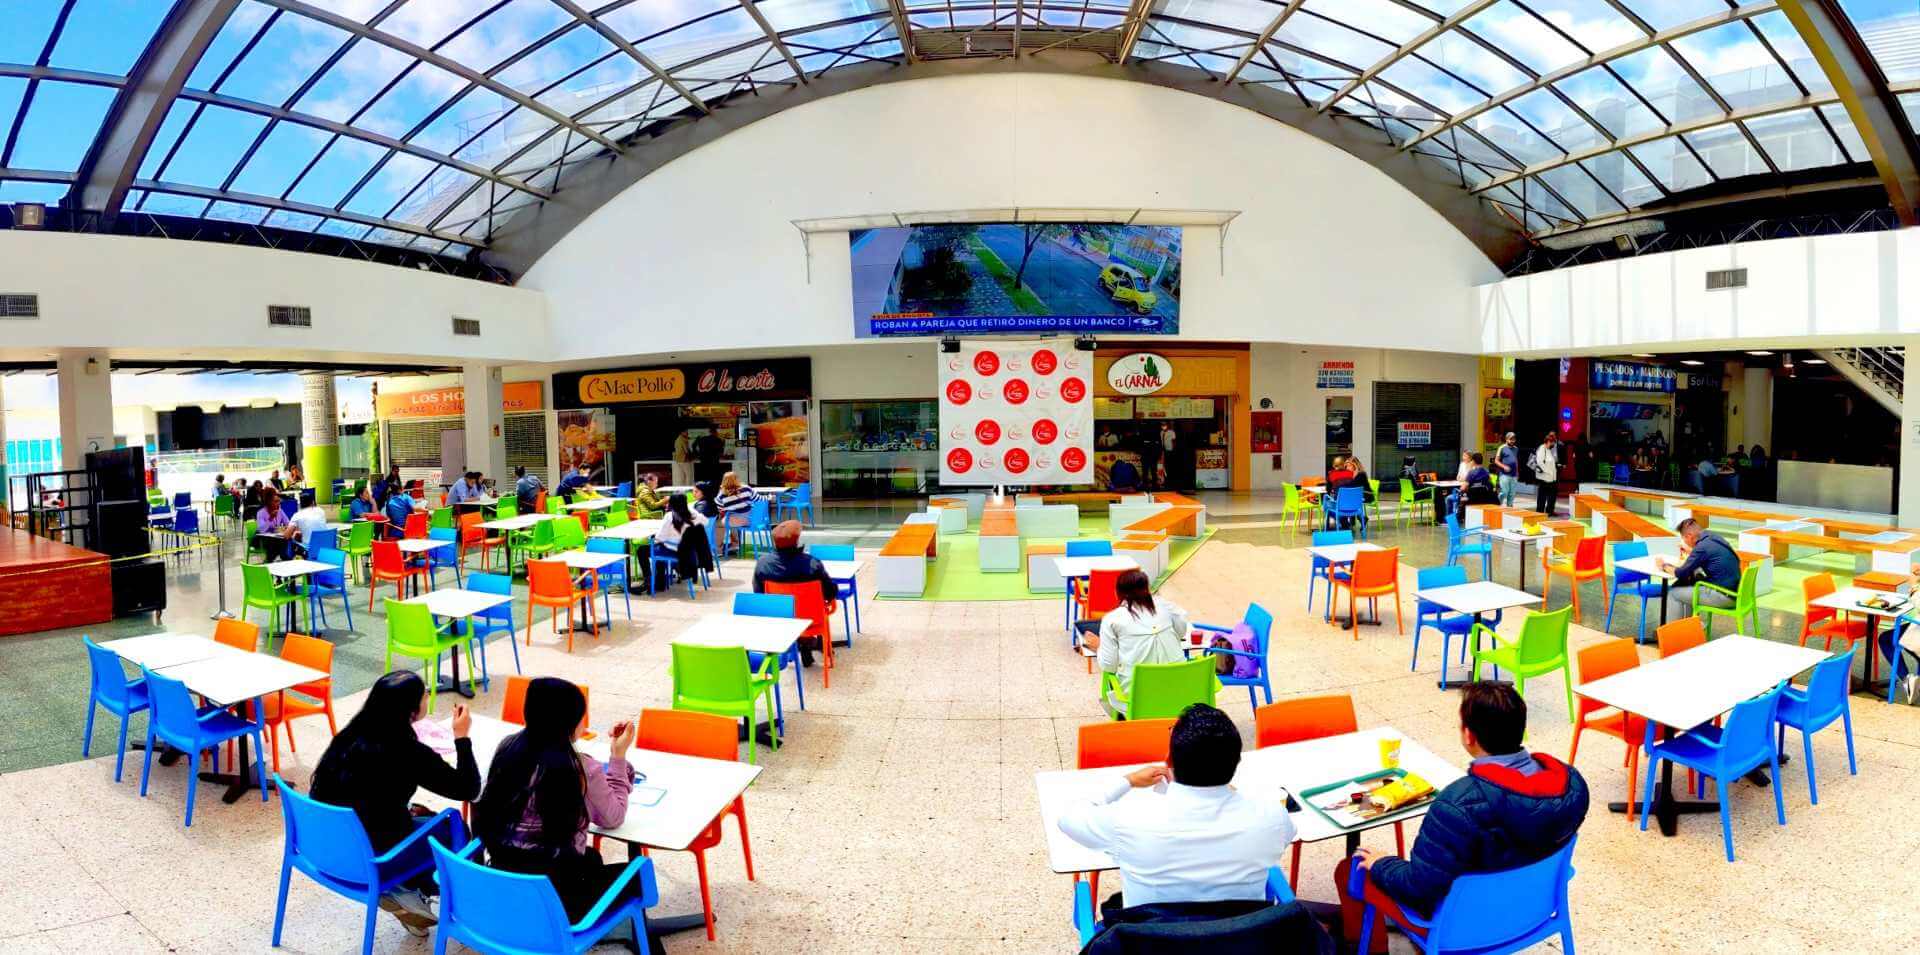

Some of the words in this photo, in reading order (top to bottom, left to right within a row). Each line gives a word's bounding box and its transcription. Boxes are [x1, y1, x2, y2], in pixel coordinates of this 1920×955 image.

[875, 321, 908, 329] ROBAN
[920, 320, 956, 328] PAREJA
[959, 319, 978, 328] QUE
[1018, 318, 1056, 326] DINERO
[1060, 318, 1071, 326] DE
[1073, 318, 1088, 326] UN
[1090, 318, 1125, 326] BANCO
[1595, 362, 1634, 376] PESCADOS
[1640, 366, 1680, 379] MARISCOS
[604, 379, 635, 396] Mac
[637, 376, 674, 394] Pollo
[1115, 378, 1123, 388] EL
[1125, 374, 1163, 390] CARNAL
[412, 391, 440, 404] LOS
[444, 391, 464, 401] HO
